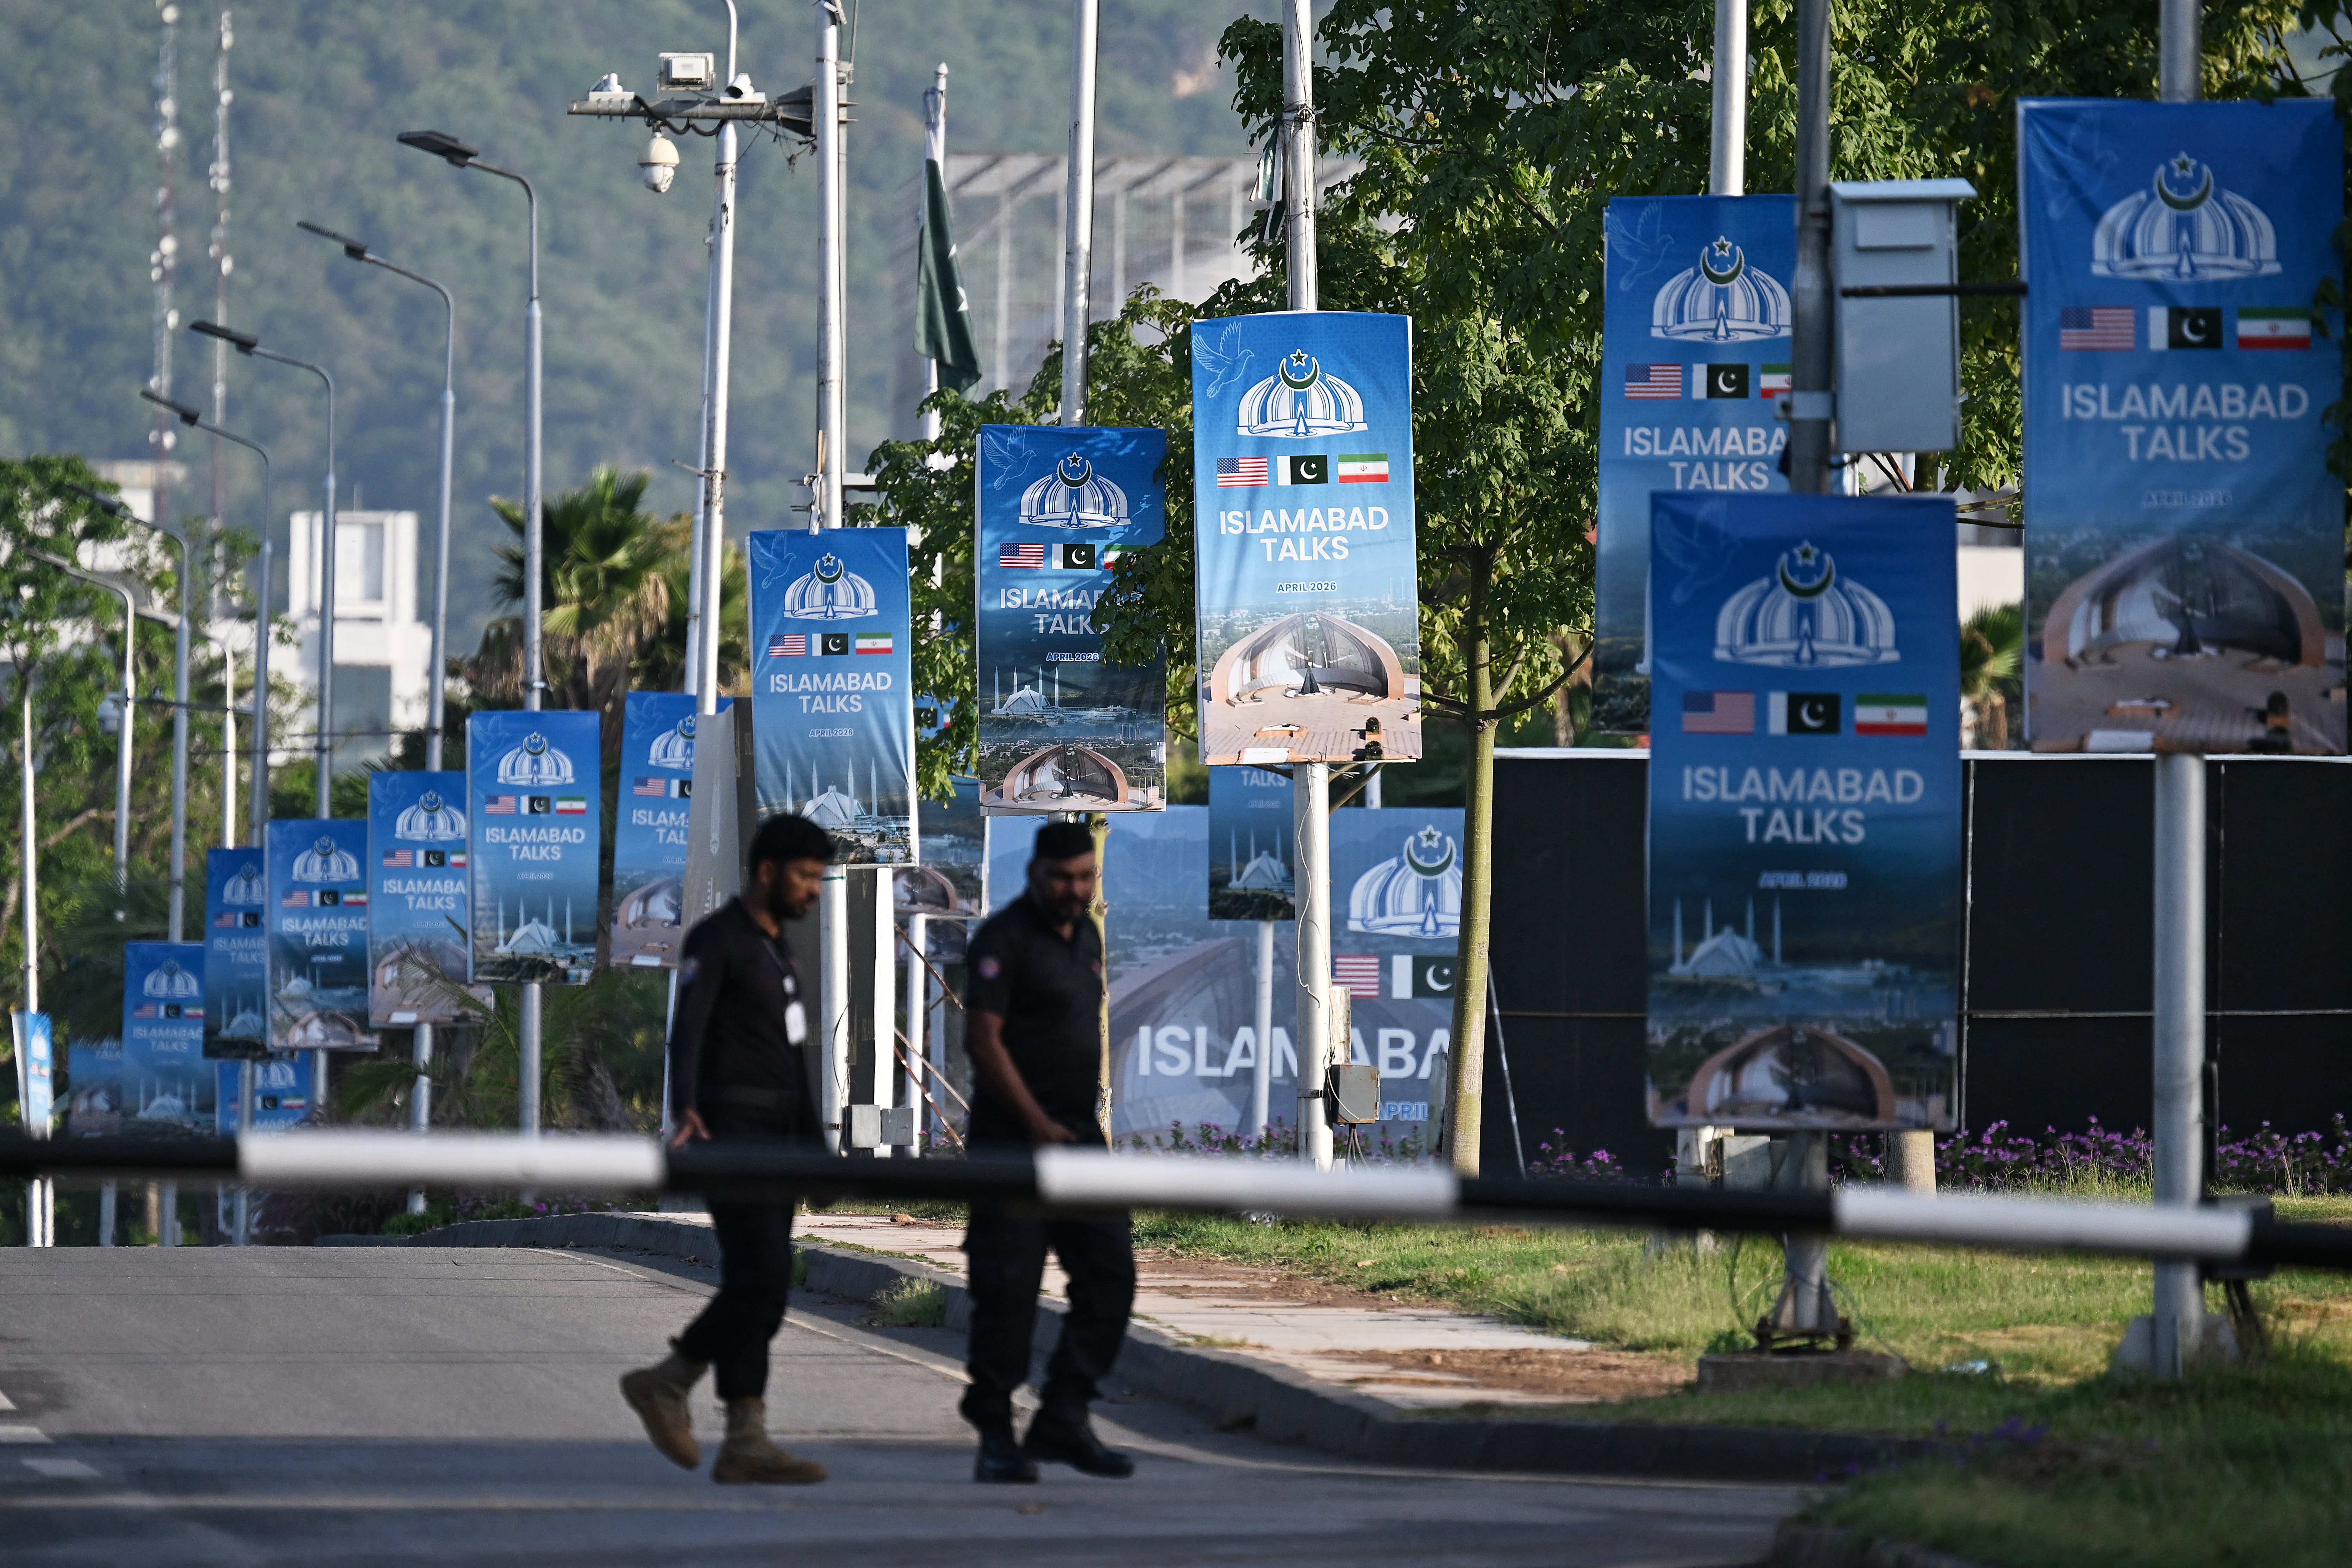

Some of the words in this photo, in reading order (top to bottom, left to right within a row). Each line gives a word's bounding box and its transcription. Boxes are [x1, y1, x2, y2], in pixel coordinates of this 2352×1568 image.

[2062, 383, 2309, 419] ISLAMABAD
[1625, 427, 1788, 456] ISLAMABA
[2121, 425, 2251, 461] TALKS
[1669, 462, 1770, 490] TALKS
[1219, 506, 1389, 534] ISLAMABAD
[1260, 536, 1349, 562] TALKS
[1276, 583, 1308, 594] APRIL
[1309, 581, 1337, 592] 2026
[1046, 652, 1074, 662] APRIL
[1075, 652, 1099, 662] 2026
[770, 672, 892, 692] ISLAMABAD
[798, 694, 862, 713] TALKS
[809, 728, 832, 737] APRIL
[1241, 770, 1287, 787] TALKS
[1683, 766, 1925, 803] ISLAMABAD
[632, 809, 689, 827] ISLAM
[1739, 808, 1865, 843] TALKS
[486, 827, 586, 843] ISLAMABAD
[656, 827, 687, 845] TAL
[509, 844, 562, 860] TALKS
[383, 879, 466, 894] ISLAMABA
[406, 895, 456, 910] TALKS
[213, 937, 265, 951] ISLAMAB
[303, 932, 350, 947] TALKS
[1139, 1025, 1450, 1079] ISLABA
